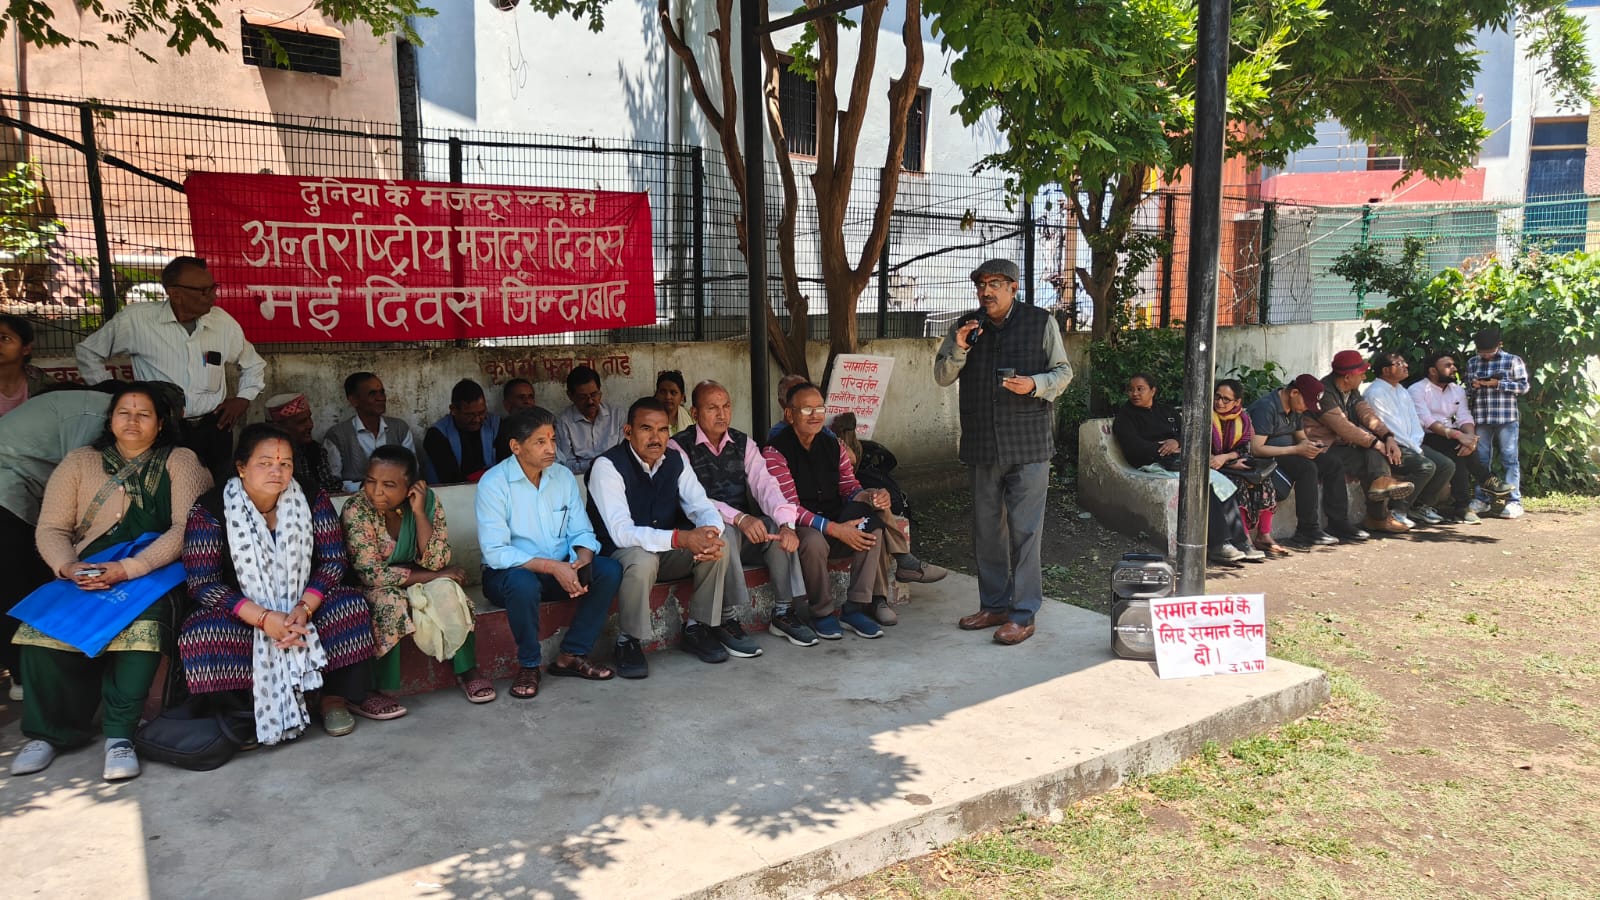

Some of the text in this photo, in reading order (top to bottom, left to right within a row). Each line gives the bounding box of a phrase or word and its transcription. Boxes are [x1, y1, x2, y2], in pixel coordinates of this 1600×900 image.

[299, 178, 380, 217] दुनिया
[383, 181, 412, 208] के
[416, 186, 512, 221] मजदूर
[241, 212, 628, 279] अन्तर्राष्ट्रीय मजदूर दिवस
[246, 275, 629, 338] मई दिवस जिन्दाबाद
[843, 359, 879, 374] सामाजिक
[840, 375, 879, 393] परिवर्तन
[1154, 596, 1251, 621] समान कार्य के
[1157, 619, 1264, 645] लिए समान वेतन
